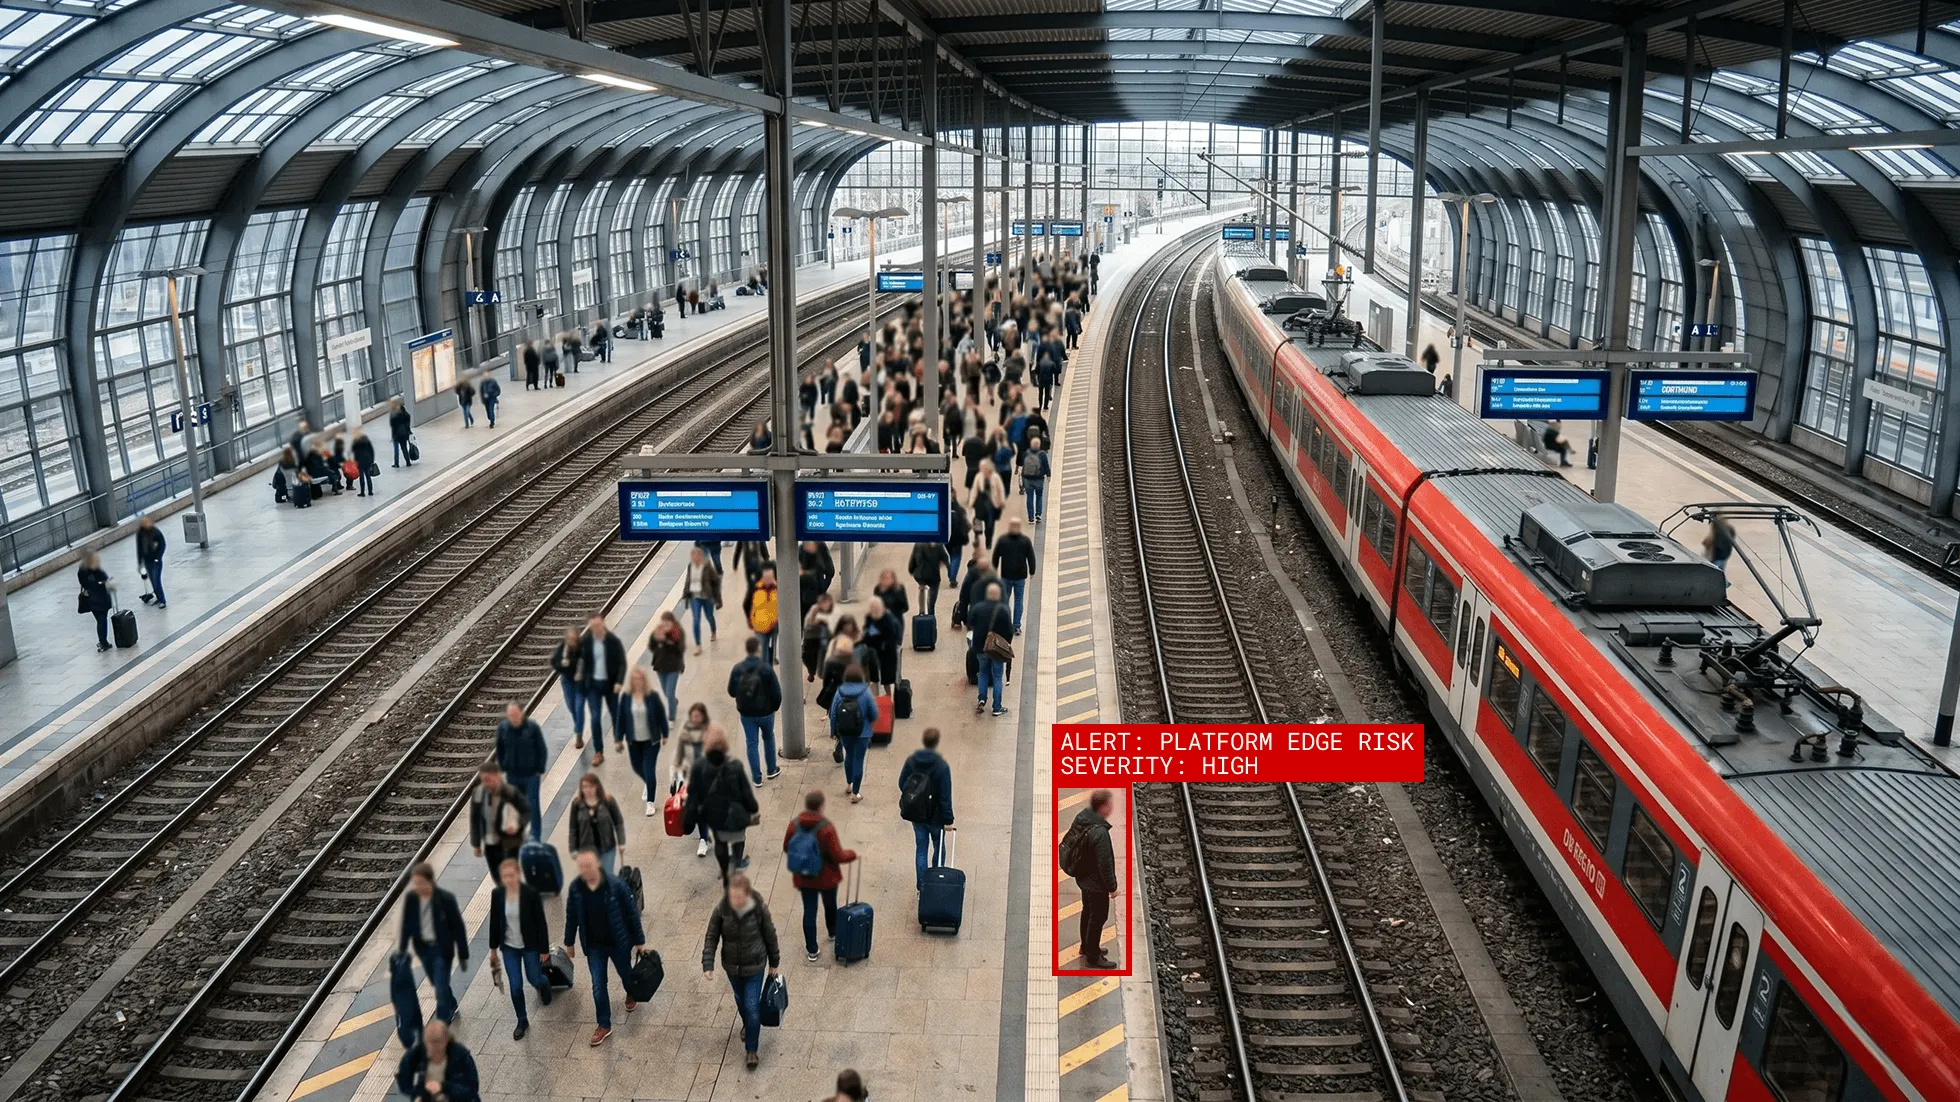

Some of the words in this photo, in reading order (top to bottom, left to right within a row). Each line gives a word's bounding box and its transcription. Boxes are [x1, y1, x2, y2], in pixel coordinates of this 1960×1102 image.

[491, 293, 500, 303] A
[1691, 324, 1700, 335] A
[1678, 868, 1687, 895] 2
[1760, 975, 1770, 1003] 2
